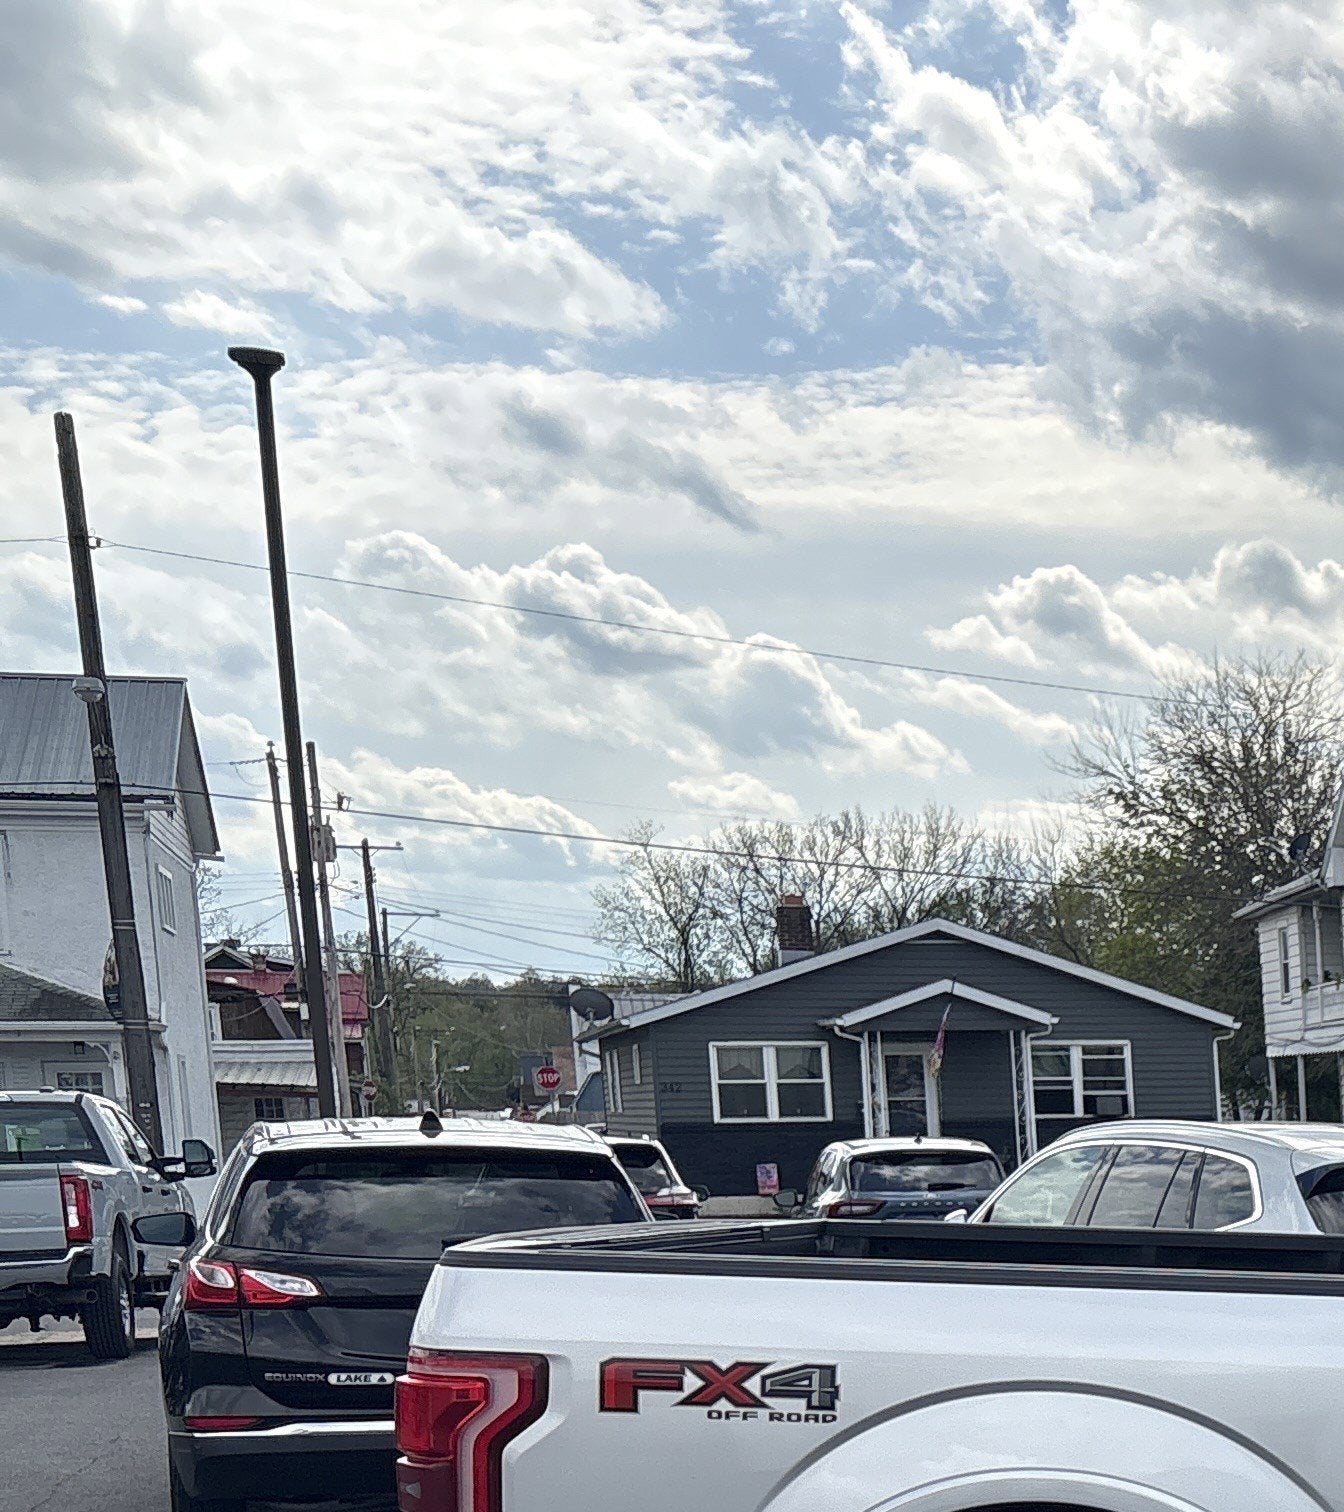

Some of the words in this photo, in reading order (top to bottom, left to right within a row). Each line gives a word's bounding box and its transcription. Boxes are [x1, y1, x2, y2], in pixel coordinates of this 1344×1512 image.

[537, 1073, 561, 1085] STOP
[264, 1373, 326, 1381] EQUINOX
[336, 1374, 372, 1383] LAKE
[599, 1357, 841, 1413] FX4
[707, 1409, 759, 1421] OFF
[768, 1412, 837, 1424] ROAD
